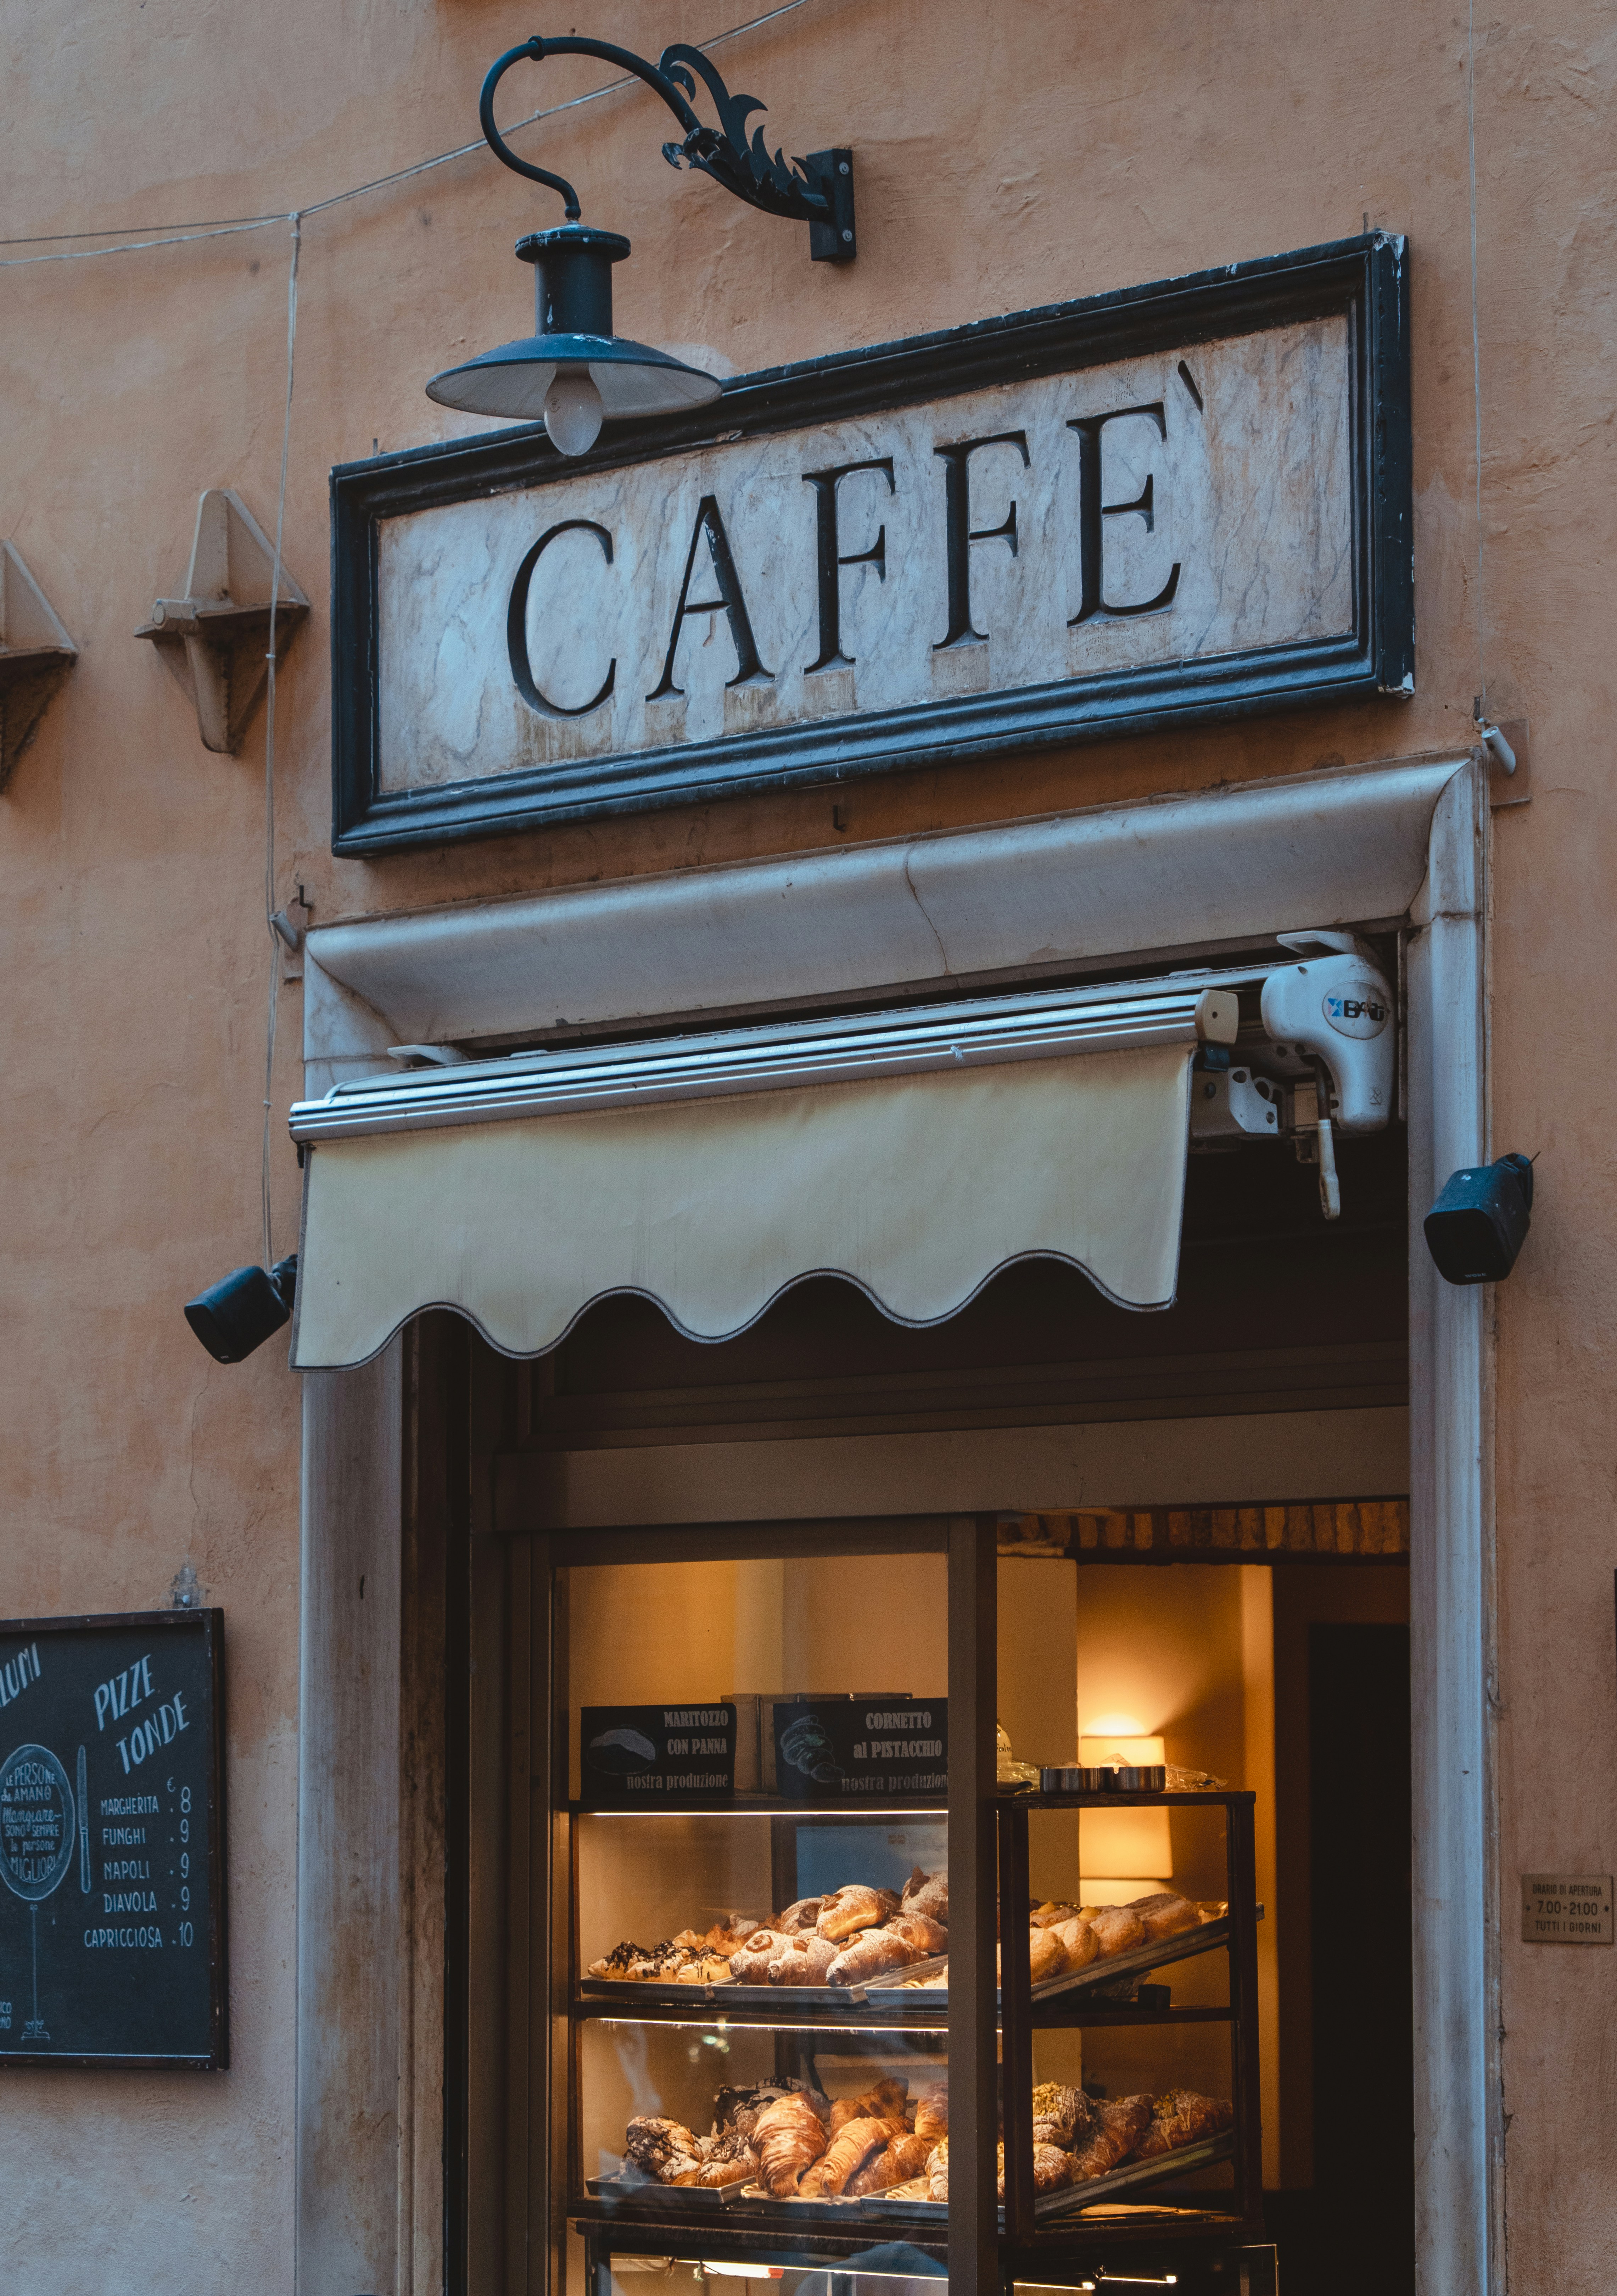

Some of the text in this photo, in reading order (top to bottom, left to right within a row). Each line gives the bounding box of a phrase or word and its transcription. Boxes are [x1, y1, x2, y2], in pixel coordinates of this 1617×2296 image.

[507, 360, 1203, 720] CAFFÈ
[0, 1642, 41, 1708] LUMI
[94, 1654, 155, 1731] PIZZE
[664, 1710, 729, 1727] MARITOZZO
[866, 1711, 932, 1730] CORNETTO
[116, 1691, 190, 1775] TONDE
[667, 1738, 727, 1755] CON PANNA
[853, 1739, 942, 1759] al PISTACCHIO
[6, 1762, 56, 1786] LE PERSONE
[627, 1772, 728, 1791] nostra produzione
[841, 1775, 884, 1792] nostra
[14, 1785, 52, 1801] AMANO
[166, 1777, 176, 1792] €
[100, 1786, 191, 1816] MARGHERITA 8
[5, 1824, 60, 1837] SONO SEMPRE
[102, 1819, 190, 1845] FUNGHI 9
[22, 1839, 56, 1856] persone
[10, 1855, 56, 1881] MIGLIORI
[104, 1852, 190, 1880] NAPOLI 9
[103, 1886, 190, 1913] DIAVOLA 9
[1532, 1884, 1602, 1897] ORARIO DI APERTURA
[84, 1922, 194, 1948] CAPRICCIOSA 10
[1535, 1920, 1559, 1932] TUTTI
[1570, 1922, 1601, 1933] GIORNI
